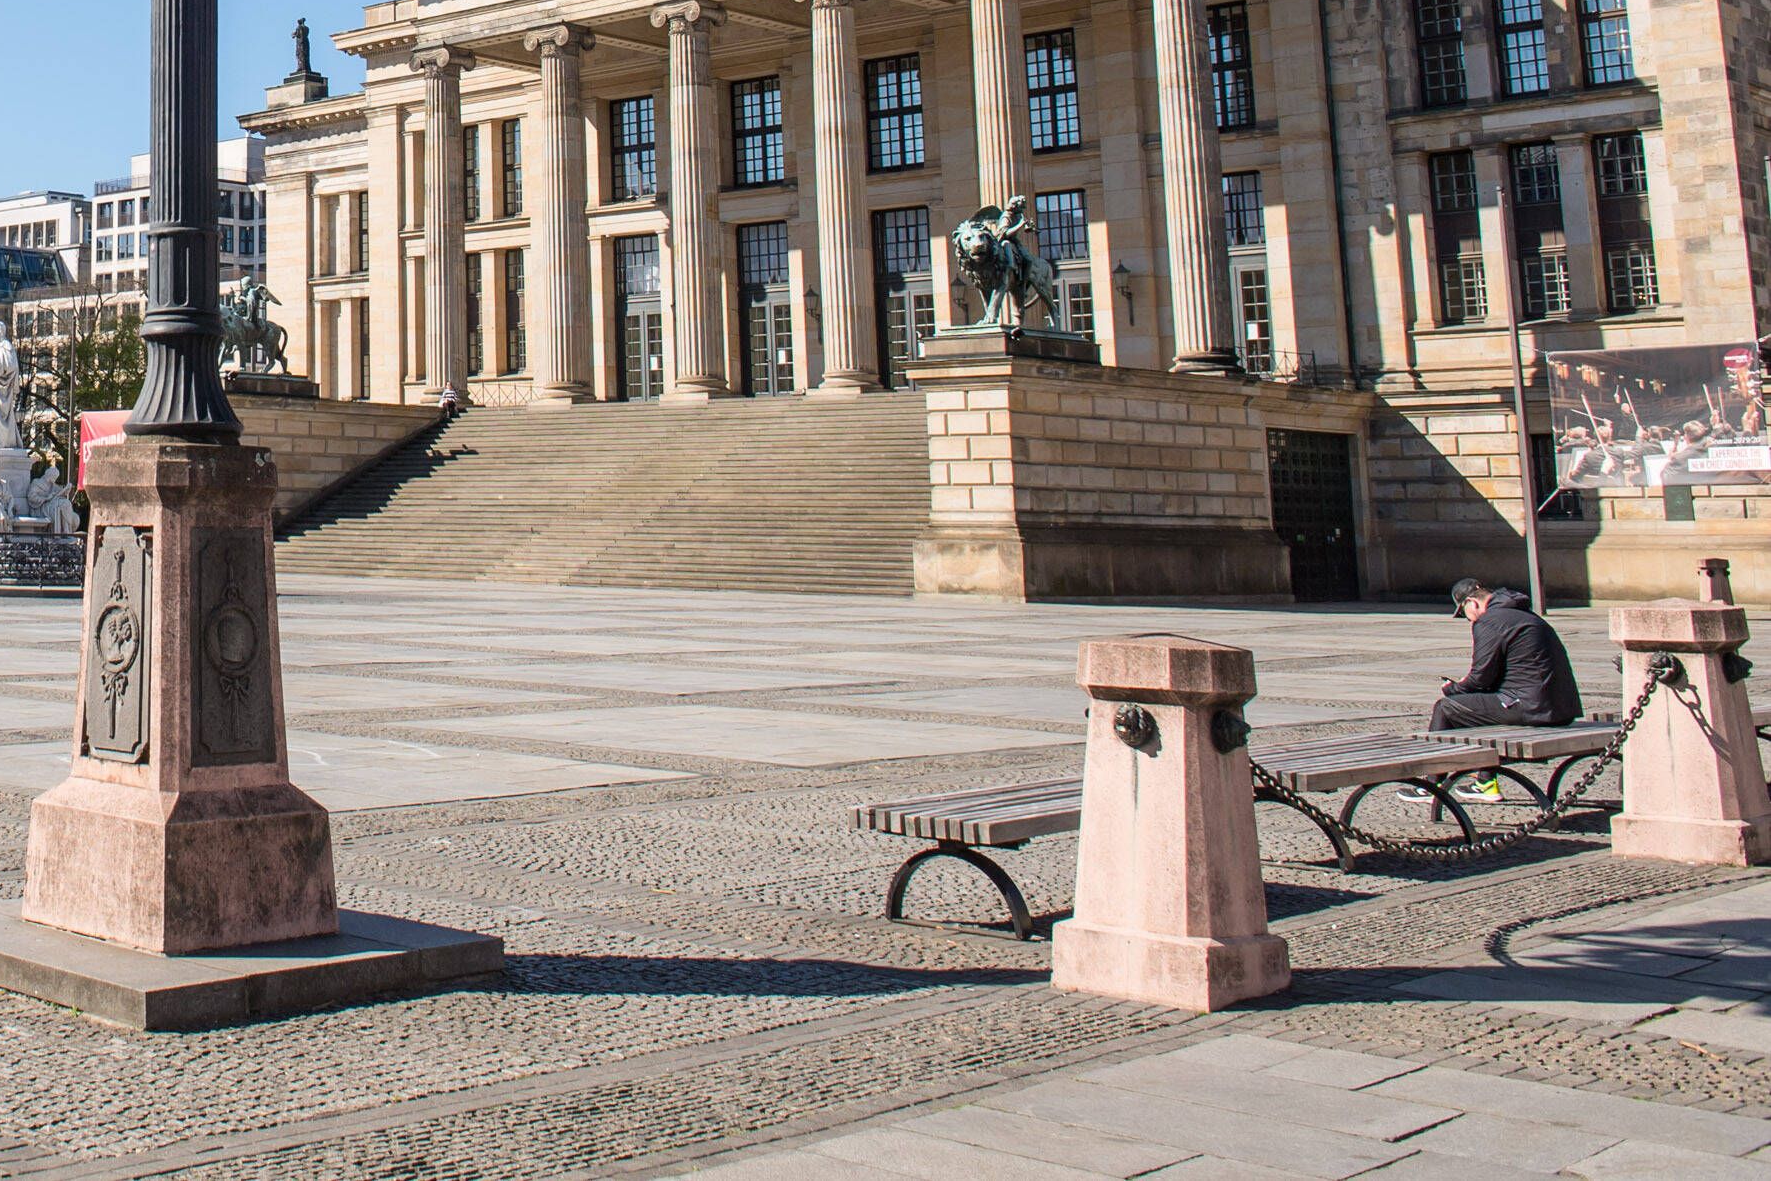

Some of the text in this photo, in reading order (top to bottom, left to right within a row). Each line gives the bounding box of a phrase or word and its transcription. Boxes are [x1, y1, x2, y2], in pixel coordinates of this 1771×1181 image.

[1711, 447, 1762, 458] EXPERIENCE THE
[1691, 460, 1705, 470] NEW
[1707, 459, 1723, 469] CHIEF
